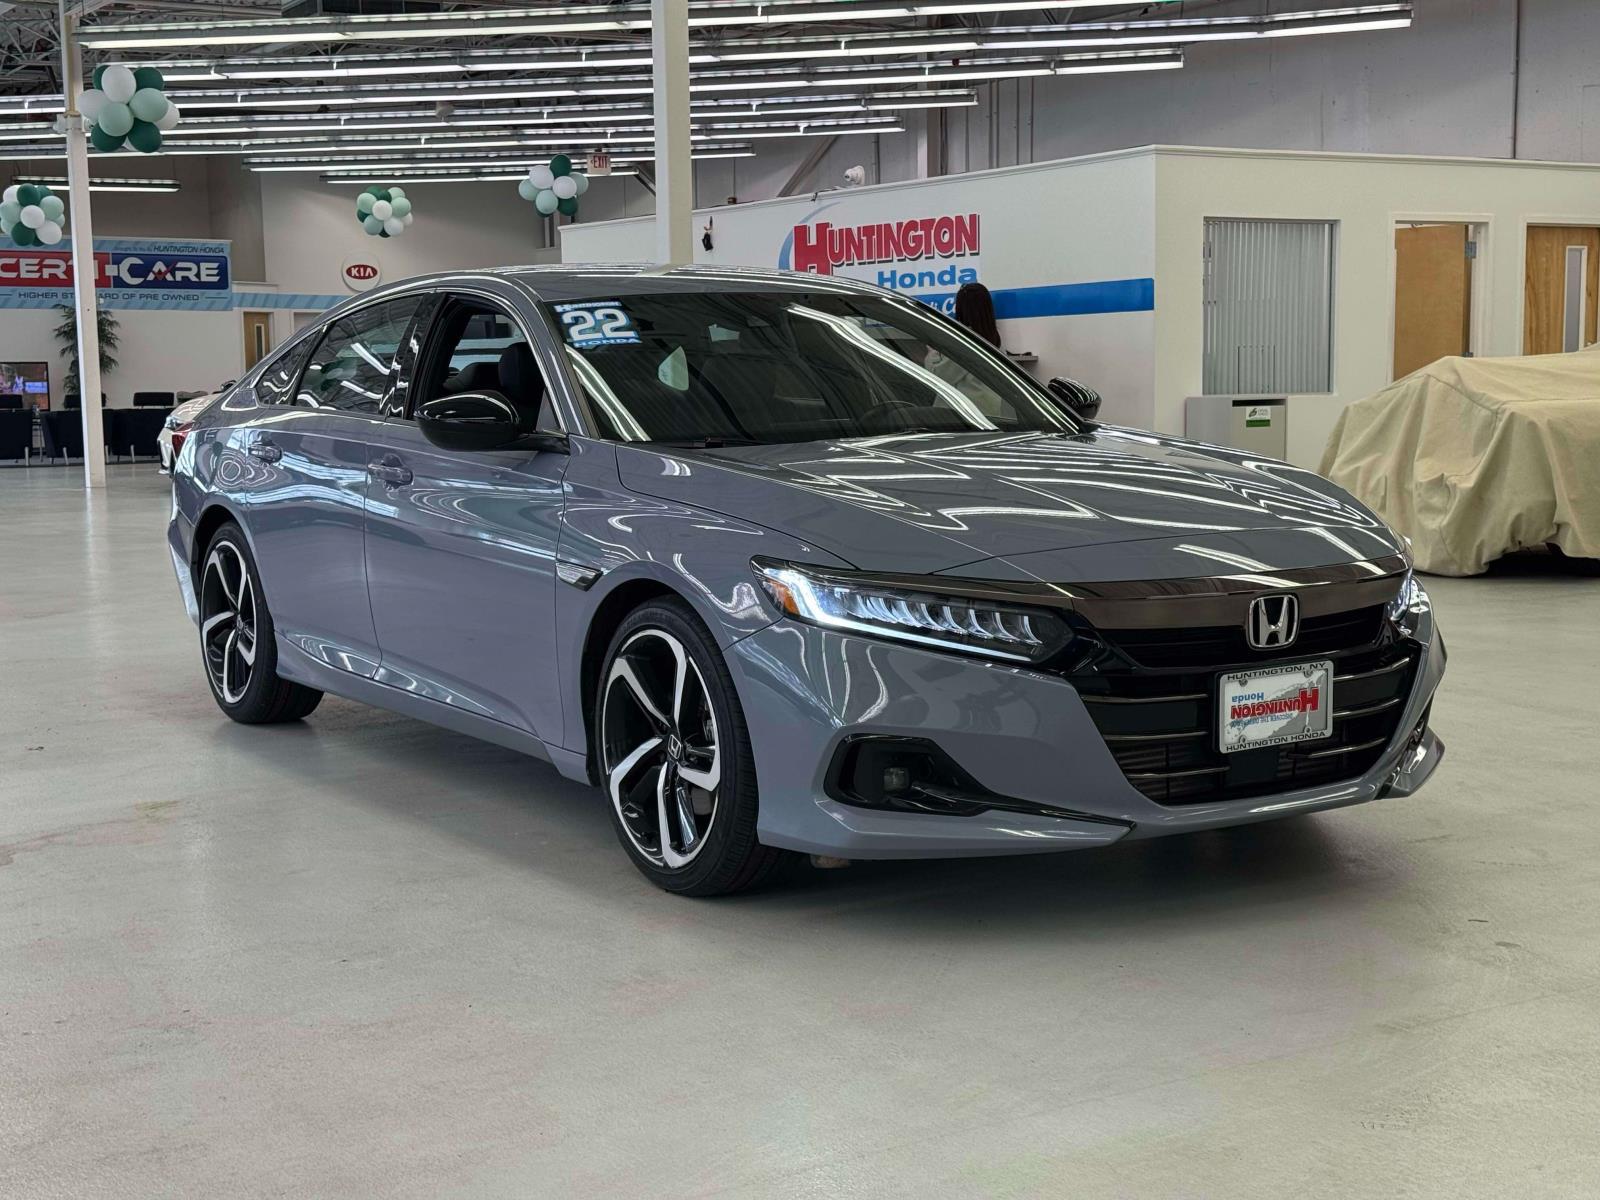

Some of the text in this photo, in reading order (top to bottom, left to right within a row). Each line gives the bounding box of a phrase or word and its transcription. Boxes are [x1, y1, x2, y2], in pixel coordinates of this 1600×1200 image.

[593, 155, 608, 168] EXIT
[153, 245, 198, 253] HUNTINGTON
[793, 213, 981, 277] HUNTINGTON
[351, 267, 374, 277] KIA
[877, 265, 978, 290] Honda
[139, 293, 159, 301] PRE
[562, 308, 636, 340] 22
[573, 338, 642, 347] HONDA
[1231, 692, 1264, 703] Honda
[1231, 687, 1319, 719] HUNTINGTON
[1226, 731, 1326, 751] HUNTINGTON HONDA
